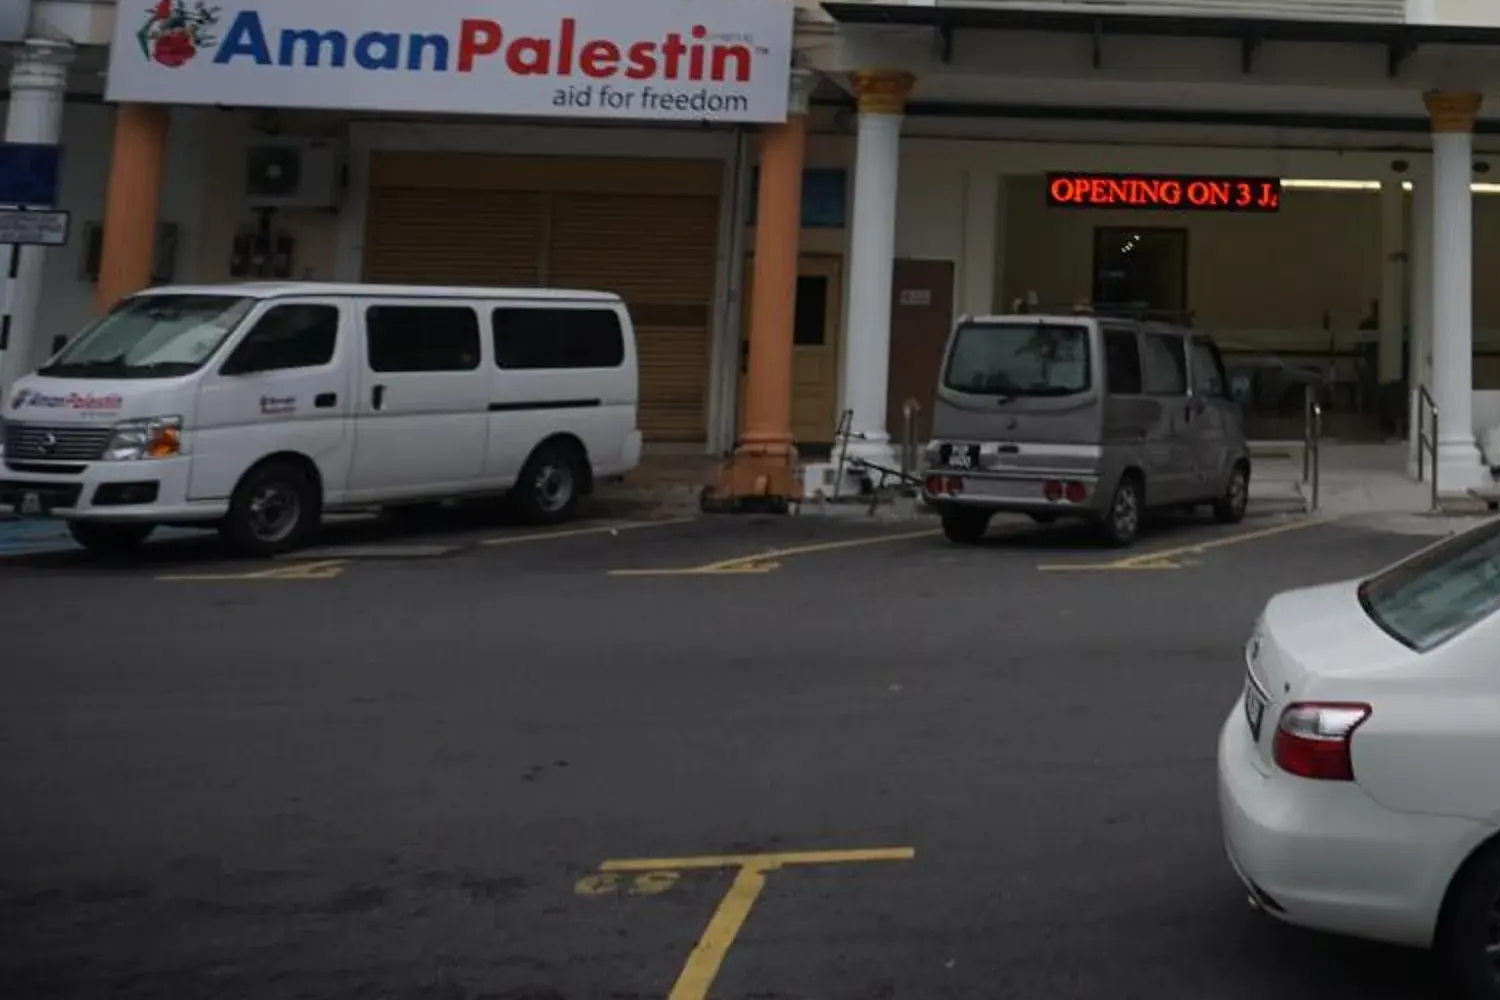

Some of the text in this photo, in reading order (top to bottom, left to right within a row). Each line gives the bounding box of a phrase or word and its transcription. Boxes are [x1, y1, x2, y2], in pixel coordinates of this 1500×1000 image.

[551, 84, 749, 113] aid for freedom
[1051, 178, 1182, 205] OPENING
[1188, 179, 1230, 206] ON
[1235, 183, 1251, 207] 3
